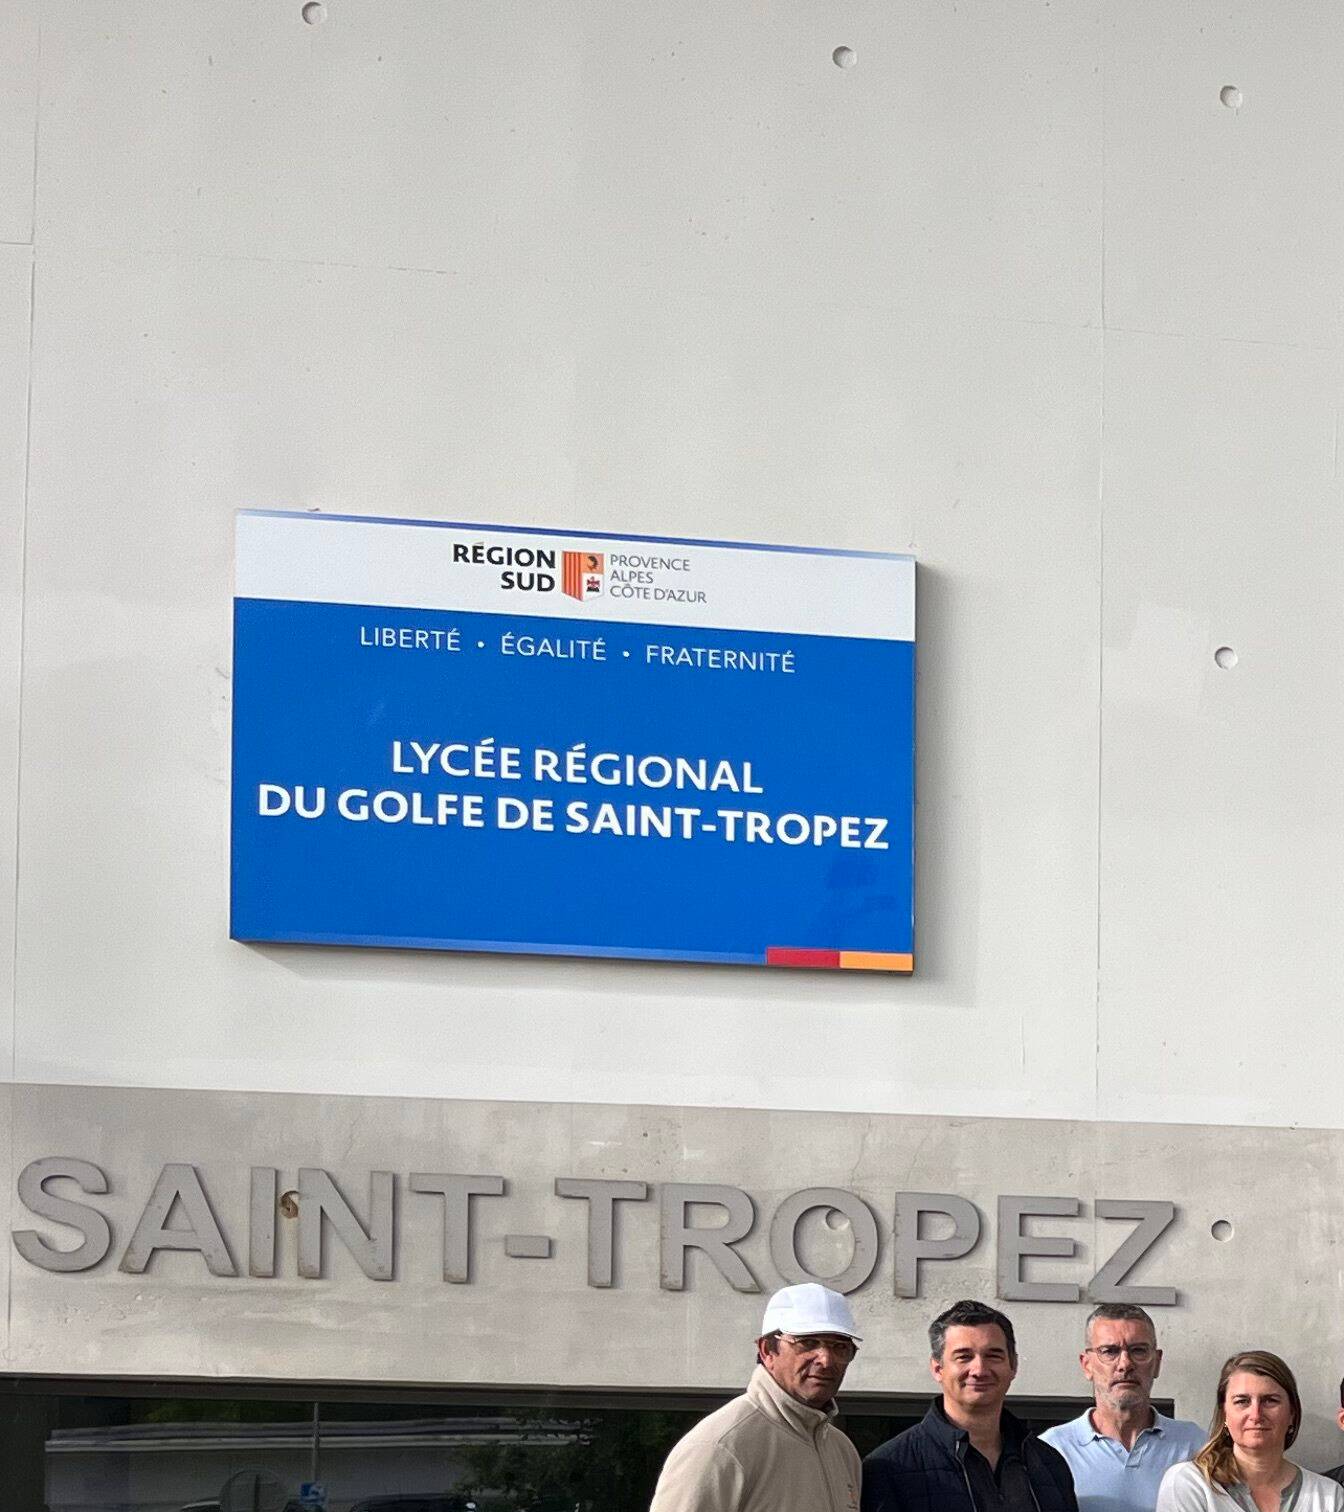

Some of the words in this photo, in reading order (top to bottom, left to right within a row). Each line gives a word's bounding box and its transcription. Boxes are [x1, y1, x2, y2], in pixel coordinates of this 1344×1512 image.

[453, 542, 556, 569] RÉGION
[610, 554, 690, 572] PROVENCE
[501, 571, 555, 592] SUD
[610, 571, 653, 584] ALPES
[610, 585, 650, 600] CÔTE
[654, 588, 707, 604] D'AZUR
[361, 626, 461, 651] LIBERTÉ
[501, 632, 606, 661] ÉGALITÉ
[646, 645, 796, 673] FRATERNITÉ
[393, 737, 521, 779] LYCÉE
[535, 743, 763, 793] RÉGIONAL
[259, 784, 325, 818] DU
[338, 789, 484, 828] GOLFE
[498, 797, 554, 831] DE
[566, 801, 889, 849] SAINT-TROPEZ
[12, 1156, 1178, 1306] SAINT-TROPEZ
